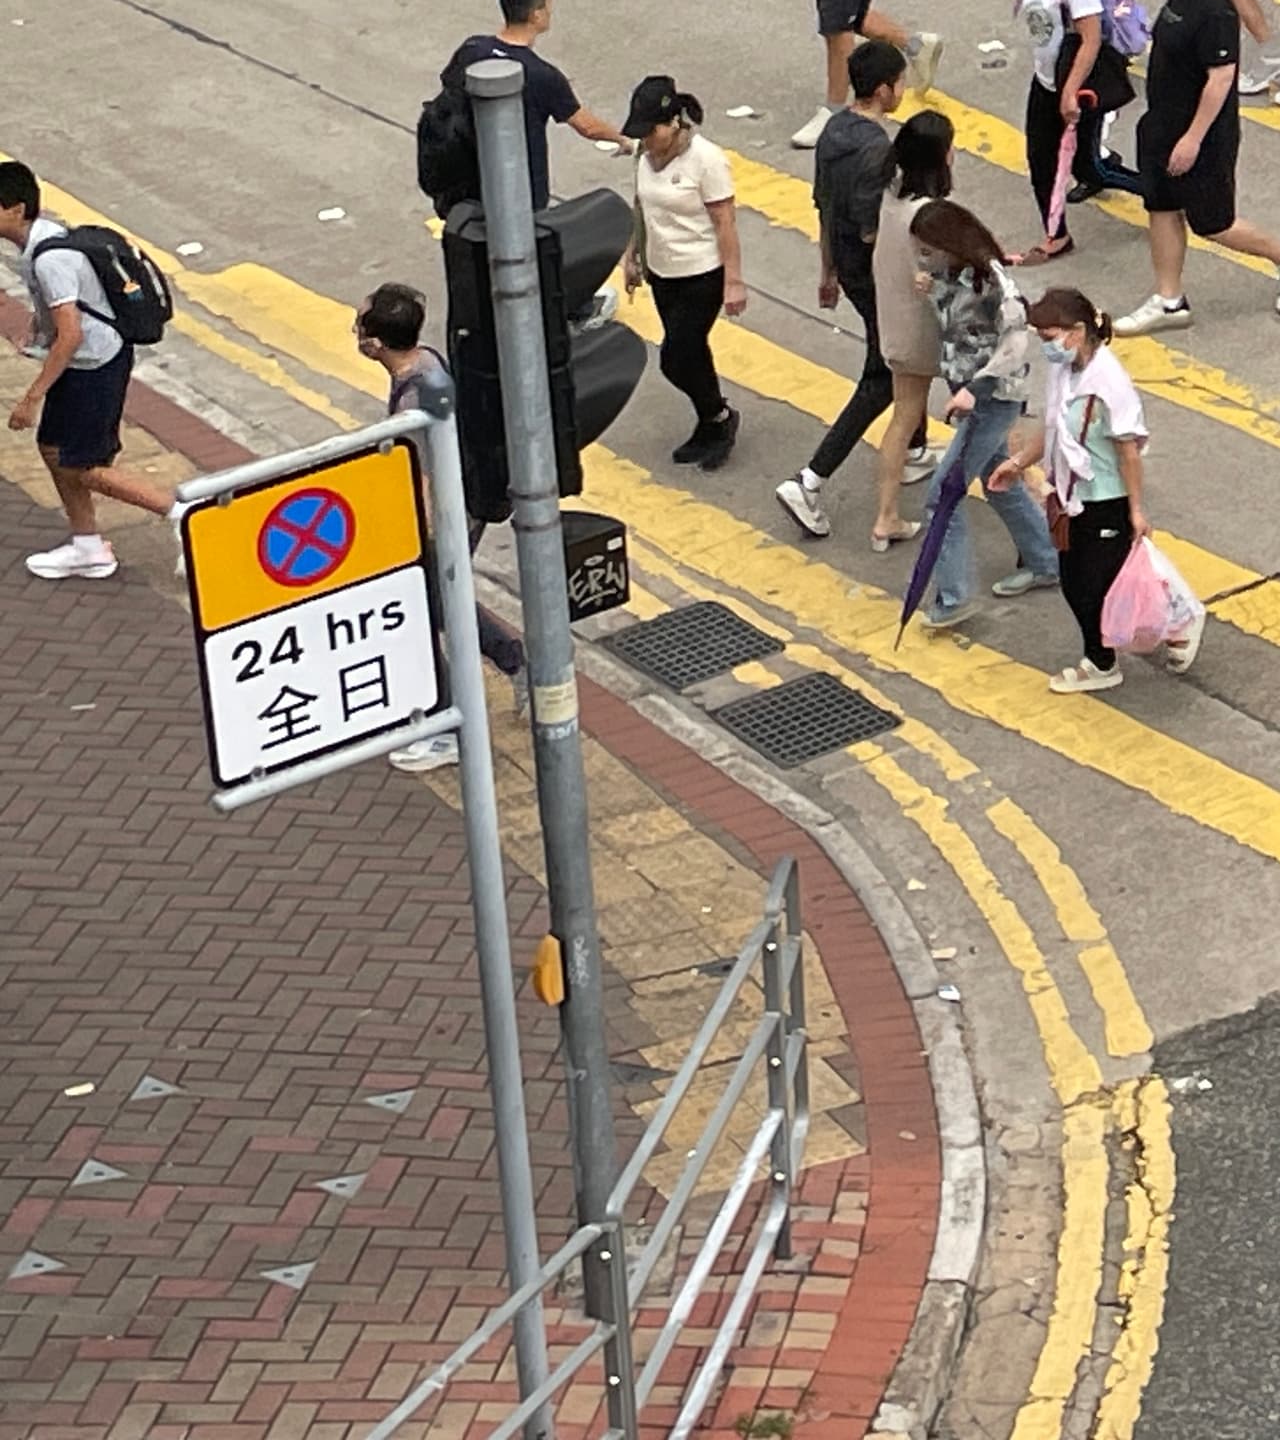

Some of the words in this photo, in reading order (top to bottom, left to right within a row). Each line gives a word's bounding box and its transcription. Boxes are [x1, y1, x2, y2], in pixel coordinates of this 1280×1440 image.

[231, 625, 304, 683] 24
[326, 598, 406, 651] hrs
[257, 654, 389, 750] 全日
